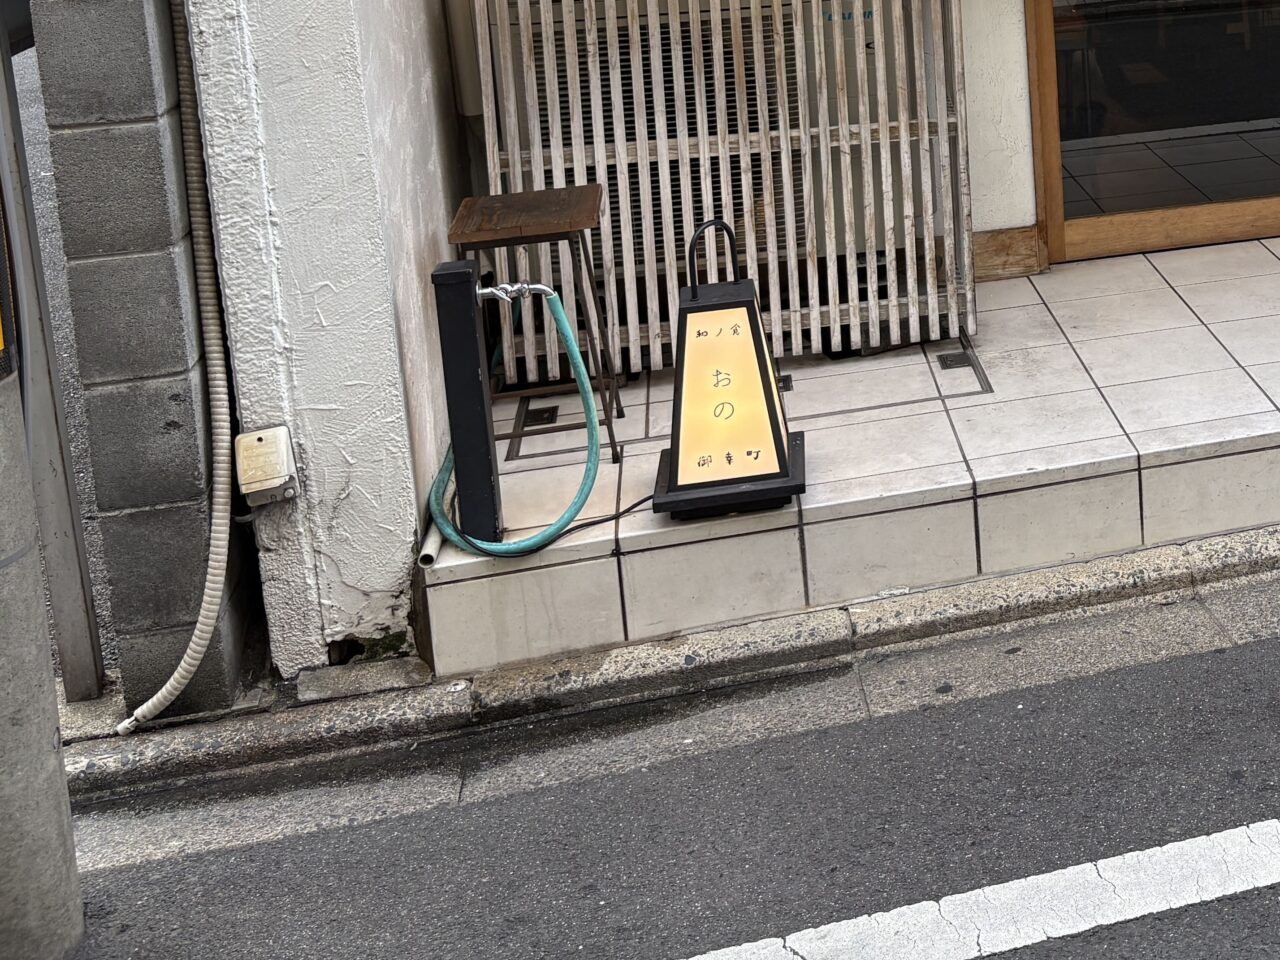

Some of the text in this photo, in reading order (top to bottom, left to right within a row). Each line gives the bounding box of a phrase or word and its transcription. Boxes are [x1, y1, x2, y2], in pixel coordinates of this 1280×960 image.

[712, 369, 735, 420] おの
[697, 450, 761, 468] 御幸町
